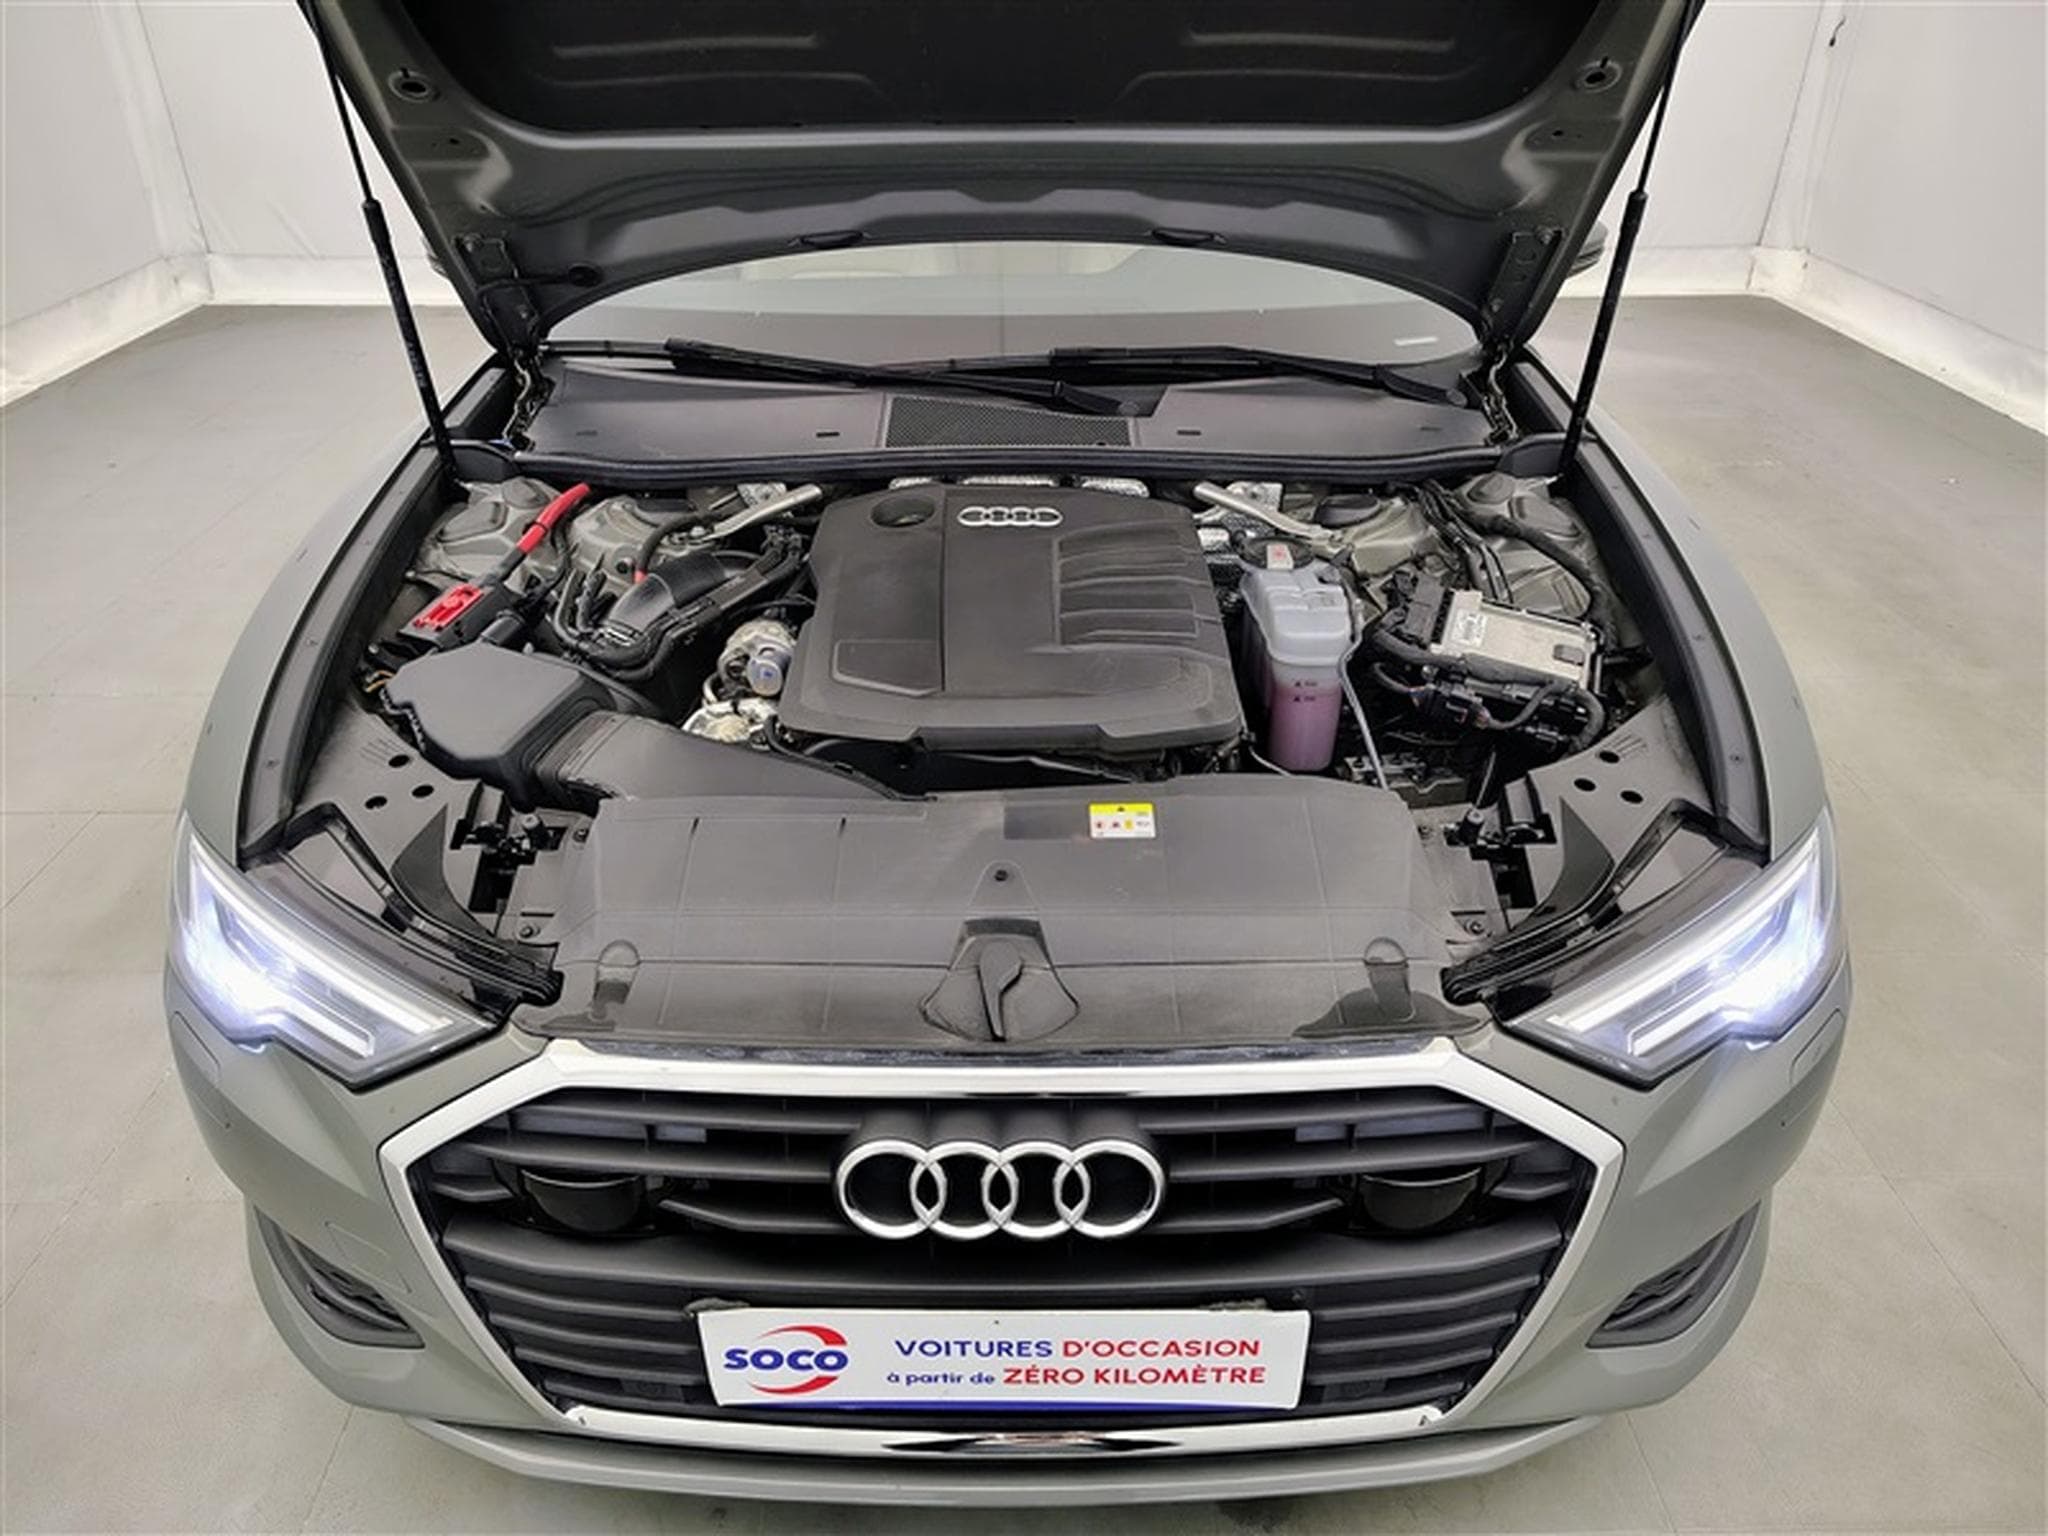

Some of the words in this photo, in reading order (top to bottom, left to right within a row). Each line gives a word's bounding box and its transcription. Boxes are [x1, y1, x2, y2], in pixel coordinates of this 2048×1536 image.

[724, 1346, 849, 1373] SOCO
[894, 1339, 1053, 1358] VOITURES
[1062, 1339, 1261, 1358] D'OCCASION
[886, 1370, 901, 1384] à
[905, 1371, 964, 1387] partir
[969, 1371, 996, 1386] de
[1002, 1363, 1085, 1386] ZÉRO
[1093, 1363, 1266, 1385] KILOMÈTRE
